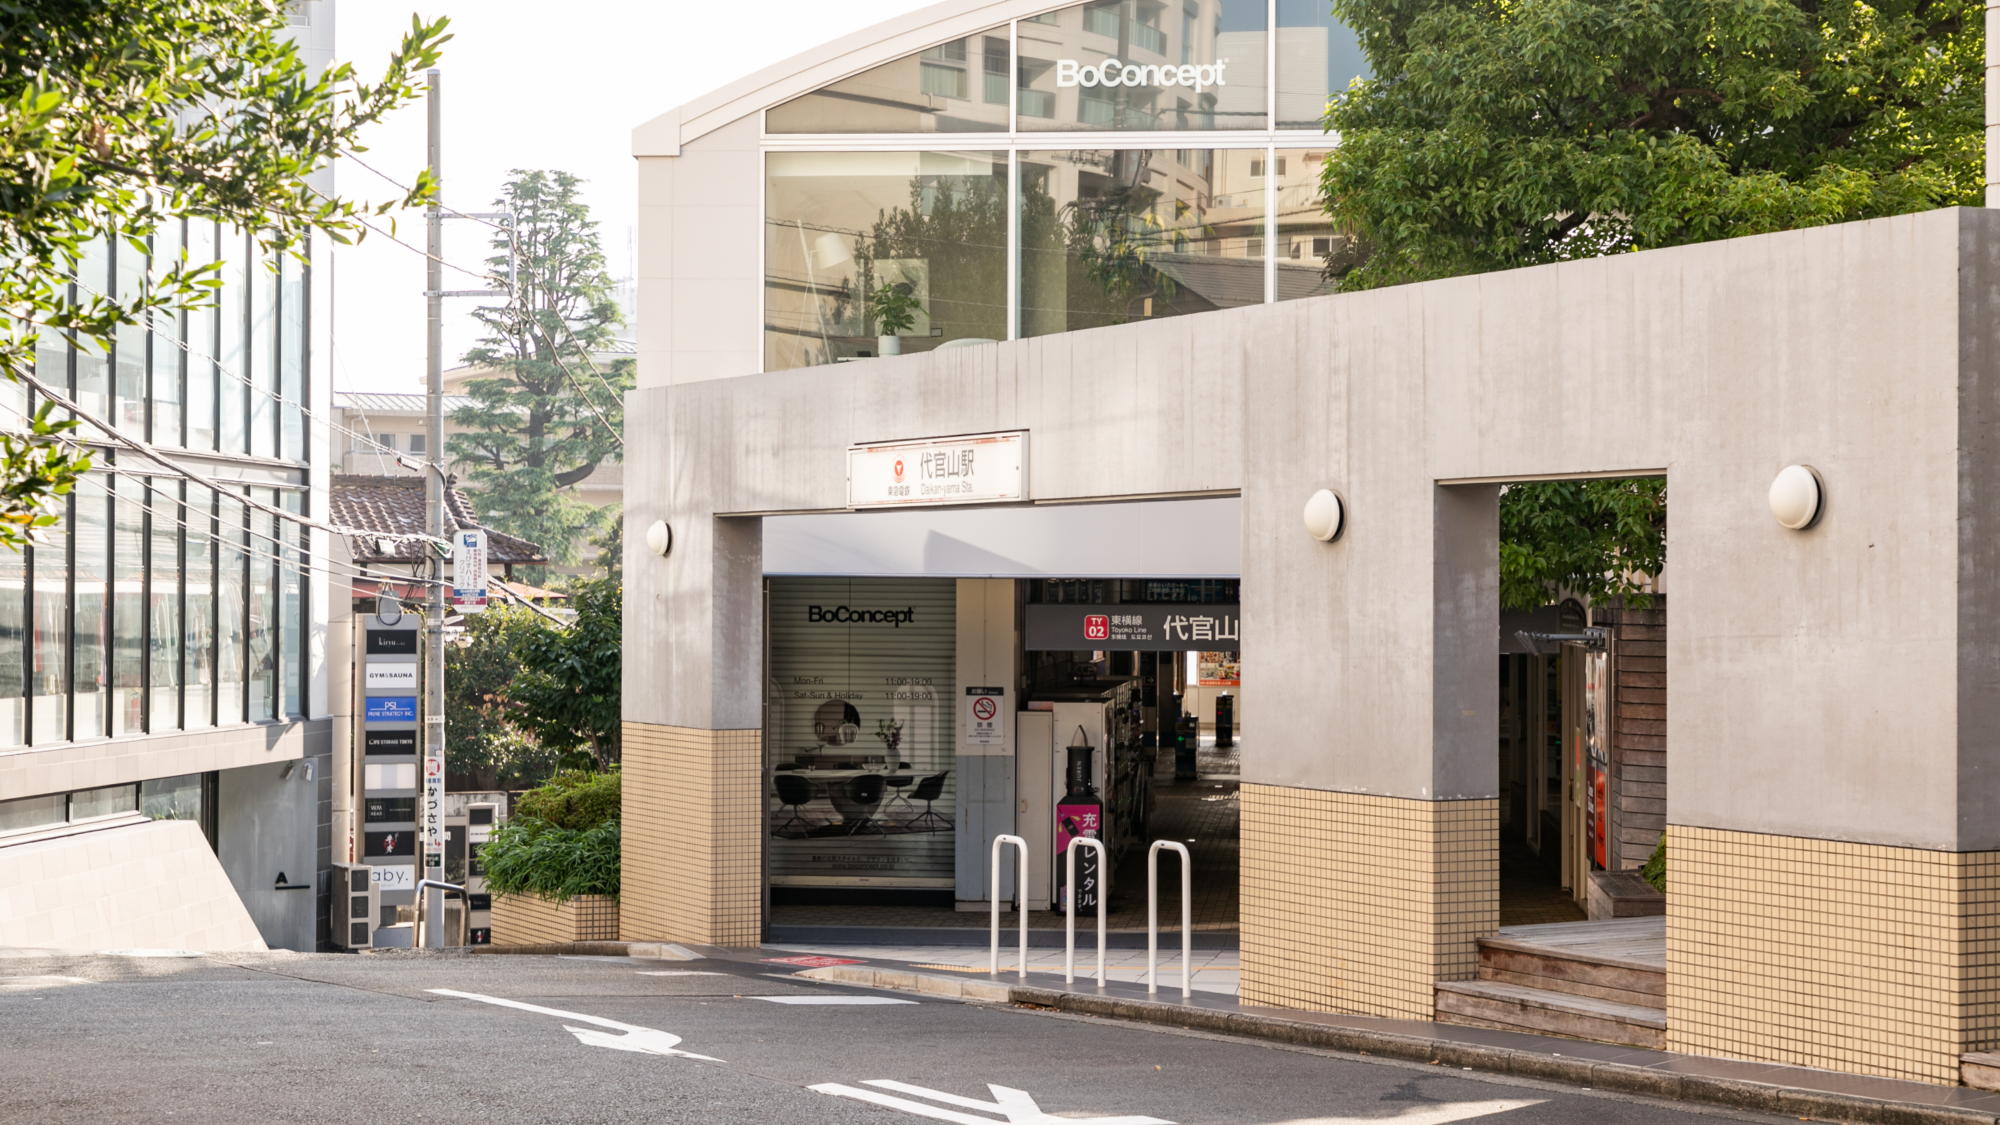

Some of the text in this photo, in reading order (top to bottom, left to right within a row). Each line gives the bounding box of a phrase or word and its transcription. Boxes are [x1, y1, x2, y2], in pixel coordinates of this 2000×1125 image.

[1056, 58, 1227, 94] BoConcept
[920, 449, 975, 479] 代官山駅
[808, 605, 915, 628] BoConcept
[1091, 617, 1103, 625] TY
[1111, 615, 1143, 626] 東横線
[1088, 626, 1105, 637] 02
[1111, 626, 1133, 634] Toyoko
[1163, 614, 1239, 641] 代官山
